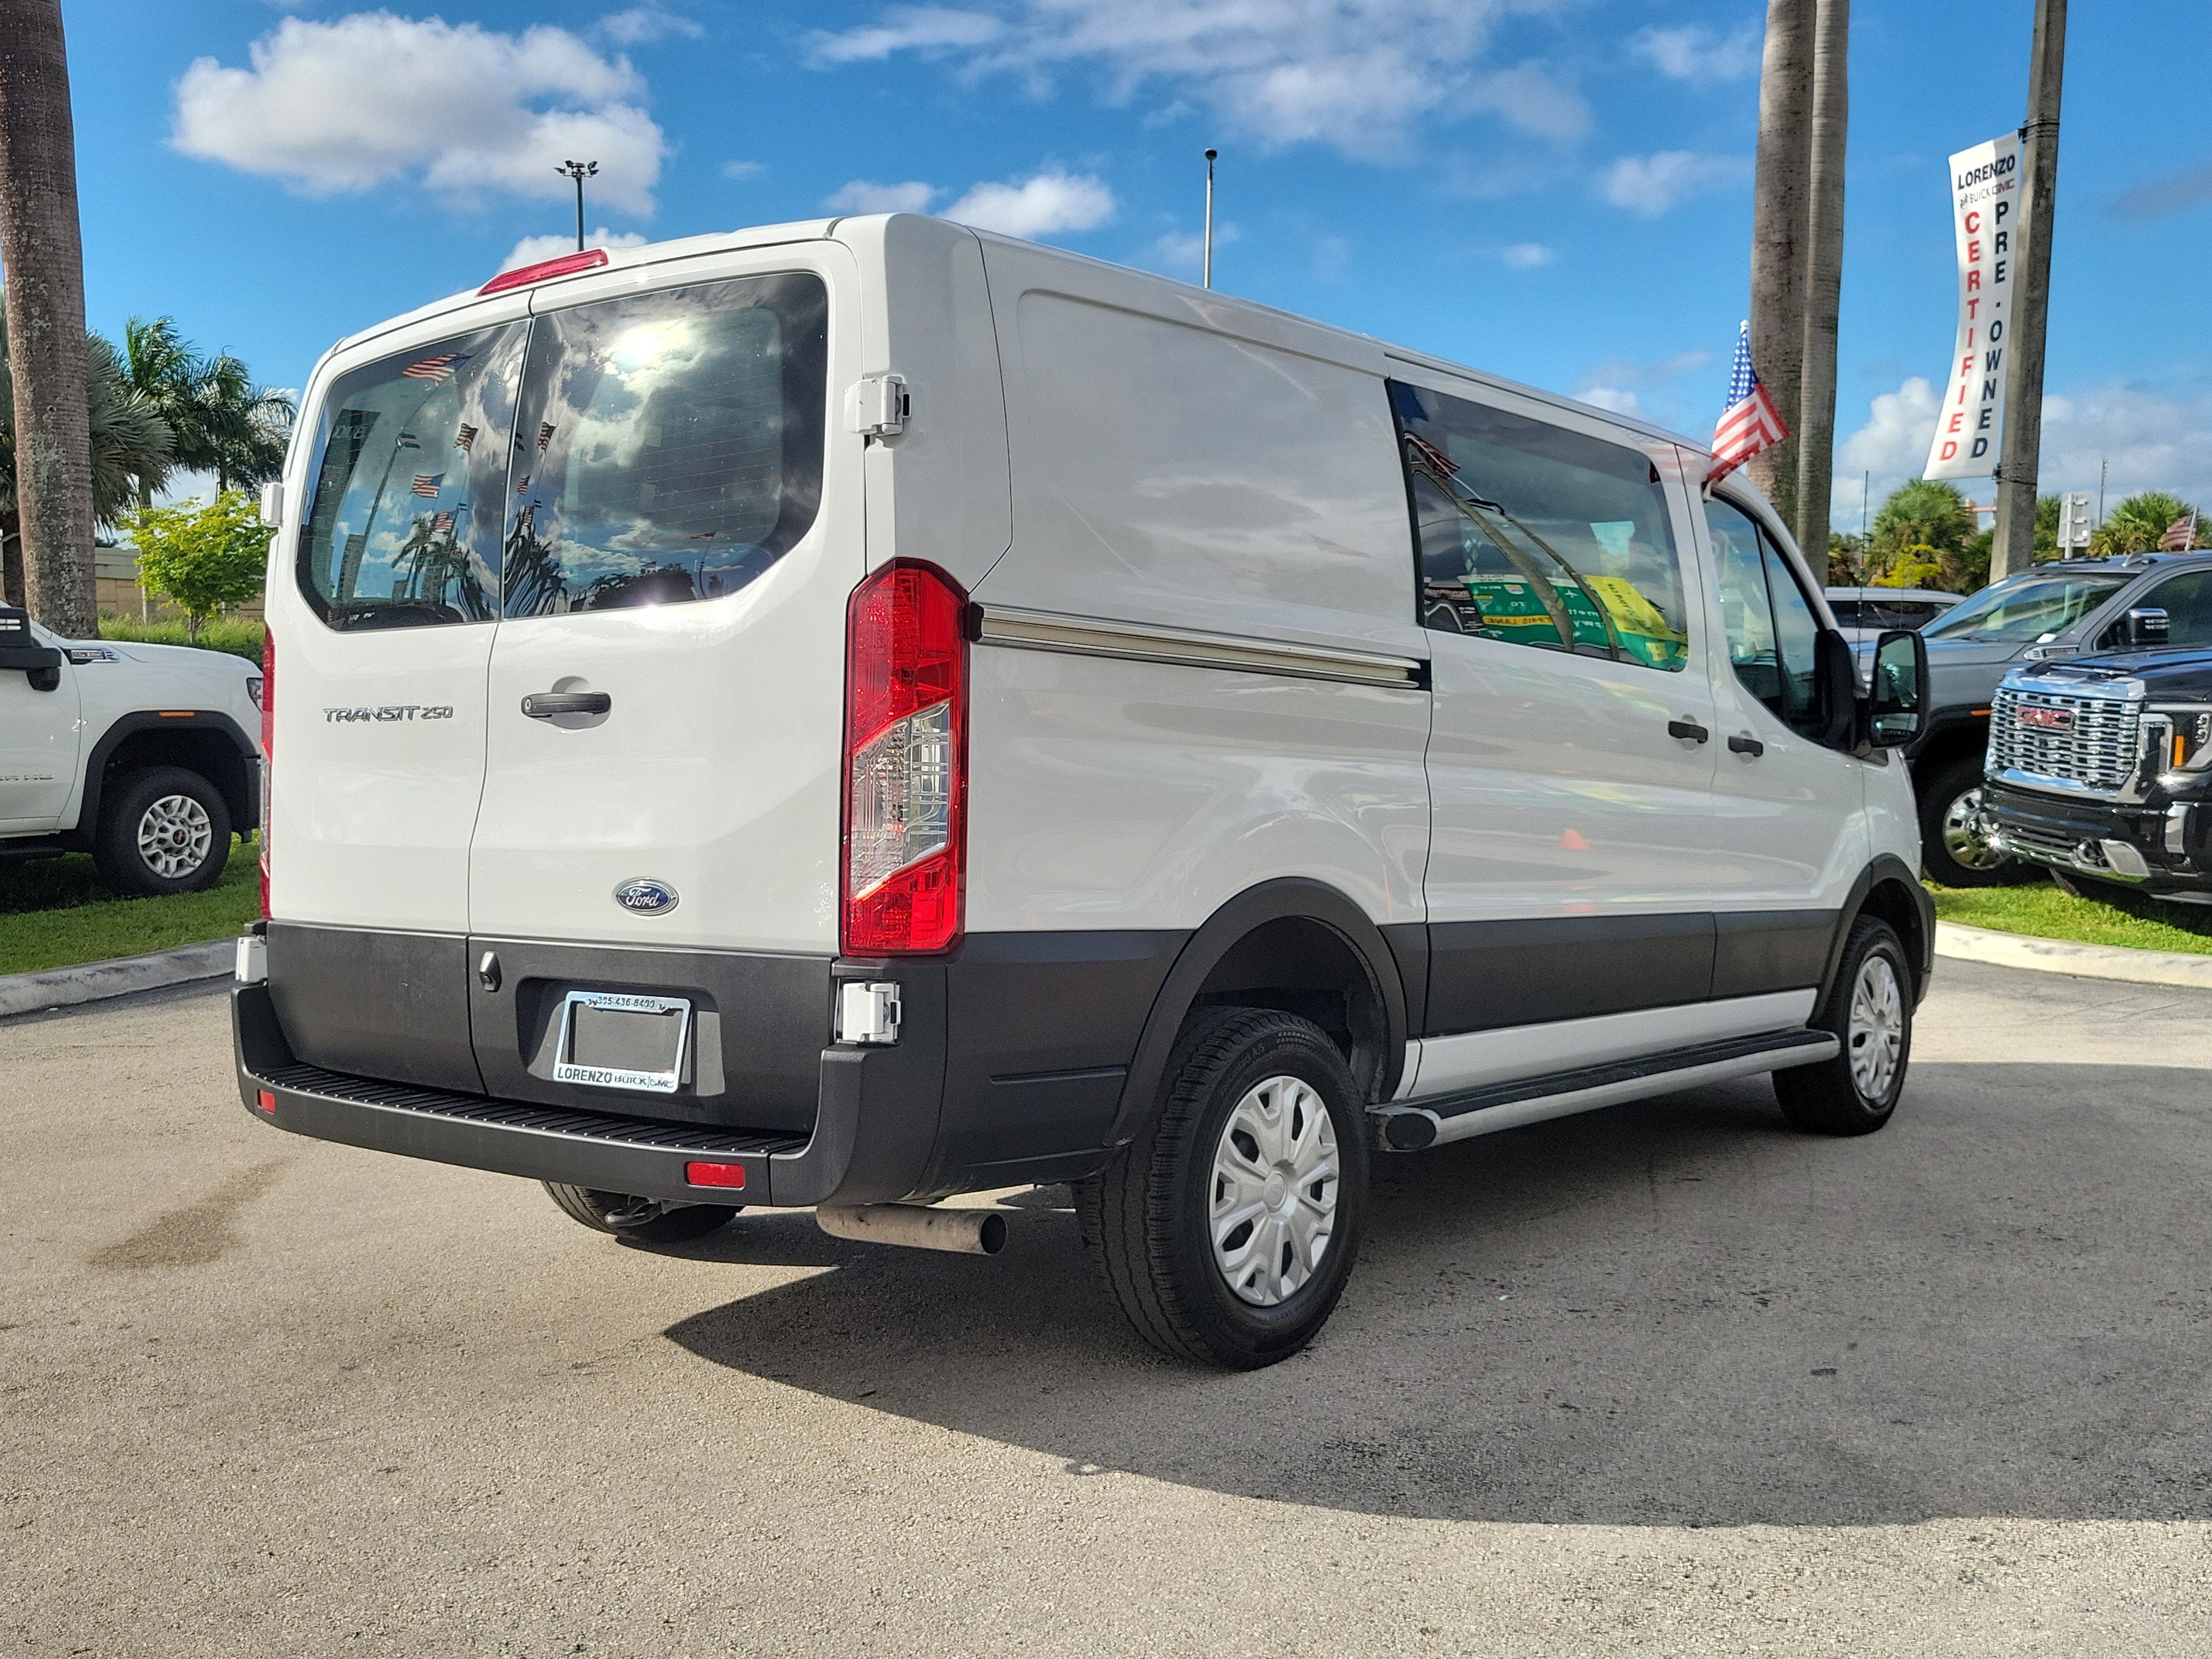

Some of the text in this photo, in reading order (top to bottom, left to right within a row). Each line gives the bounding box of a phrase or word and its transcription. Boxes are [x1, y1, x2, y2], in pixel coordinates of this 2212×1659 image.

[1957, 154, 2016, 190] LORENZO
[1969, 177, 2015, 204] BUICK GMC
[1939, 211, 1980, 461] CERTIFIED
[323, 705, 454, 723] TRANSIT 250
[2017, 705, 2072, 730] GMC
[625, 886, 661, 907] Ford
[597, 996, 656, 1008] 305-436-8400
[557, 1066, 612, 1084] LORENZO
[614, 1075, 647, 1086] BUICK
